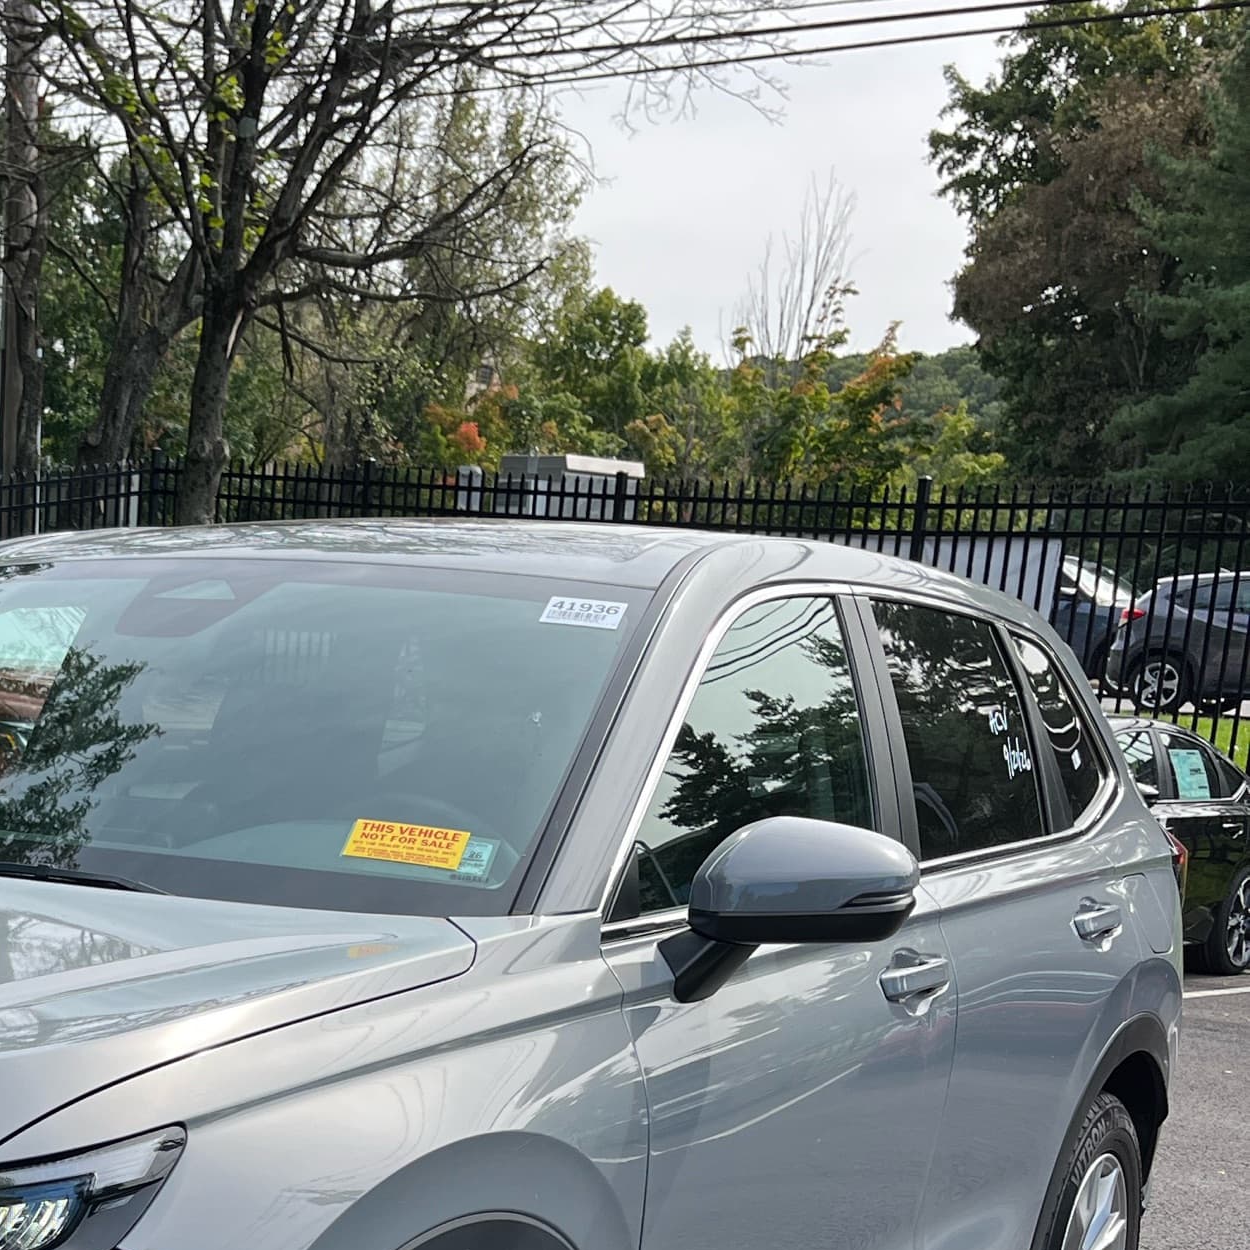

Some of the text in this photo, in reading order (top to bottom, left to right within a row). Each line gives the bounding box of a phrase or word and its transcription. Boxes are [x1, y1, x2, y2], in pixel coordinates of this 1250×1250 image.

[552, 600, 621, 615] 41936
[359, 831, 386, 842] NOT
[389, 834, 416, 846] FOR
[420, 838, 456, 850] SALE
[361, 821, 463, 843] THIS VEHICLE
